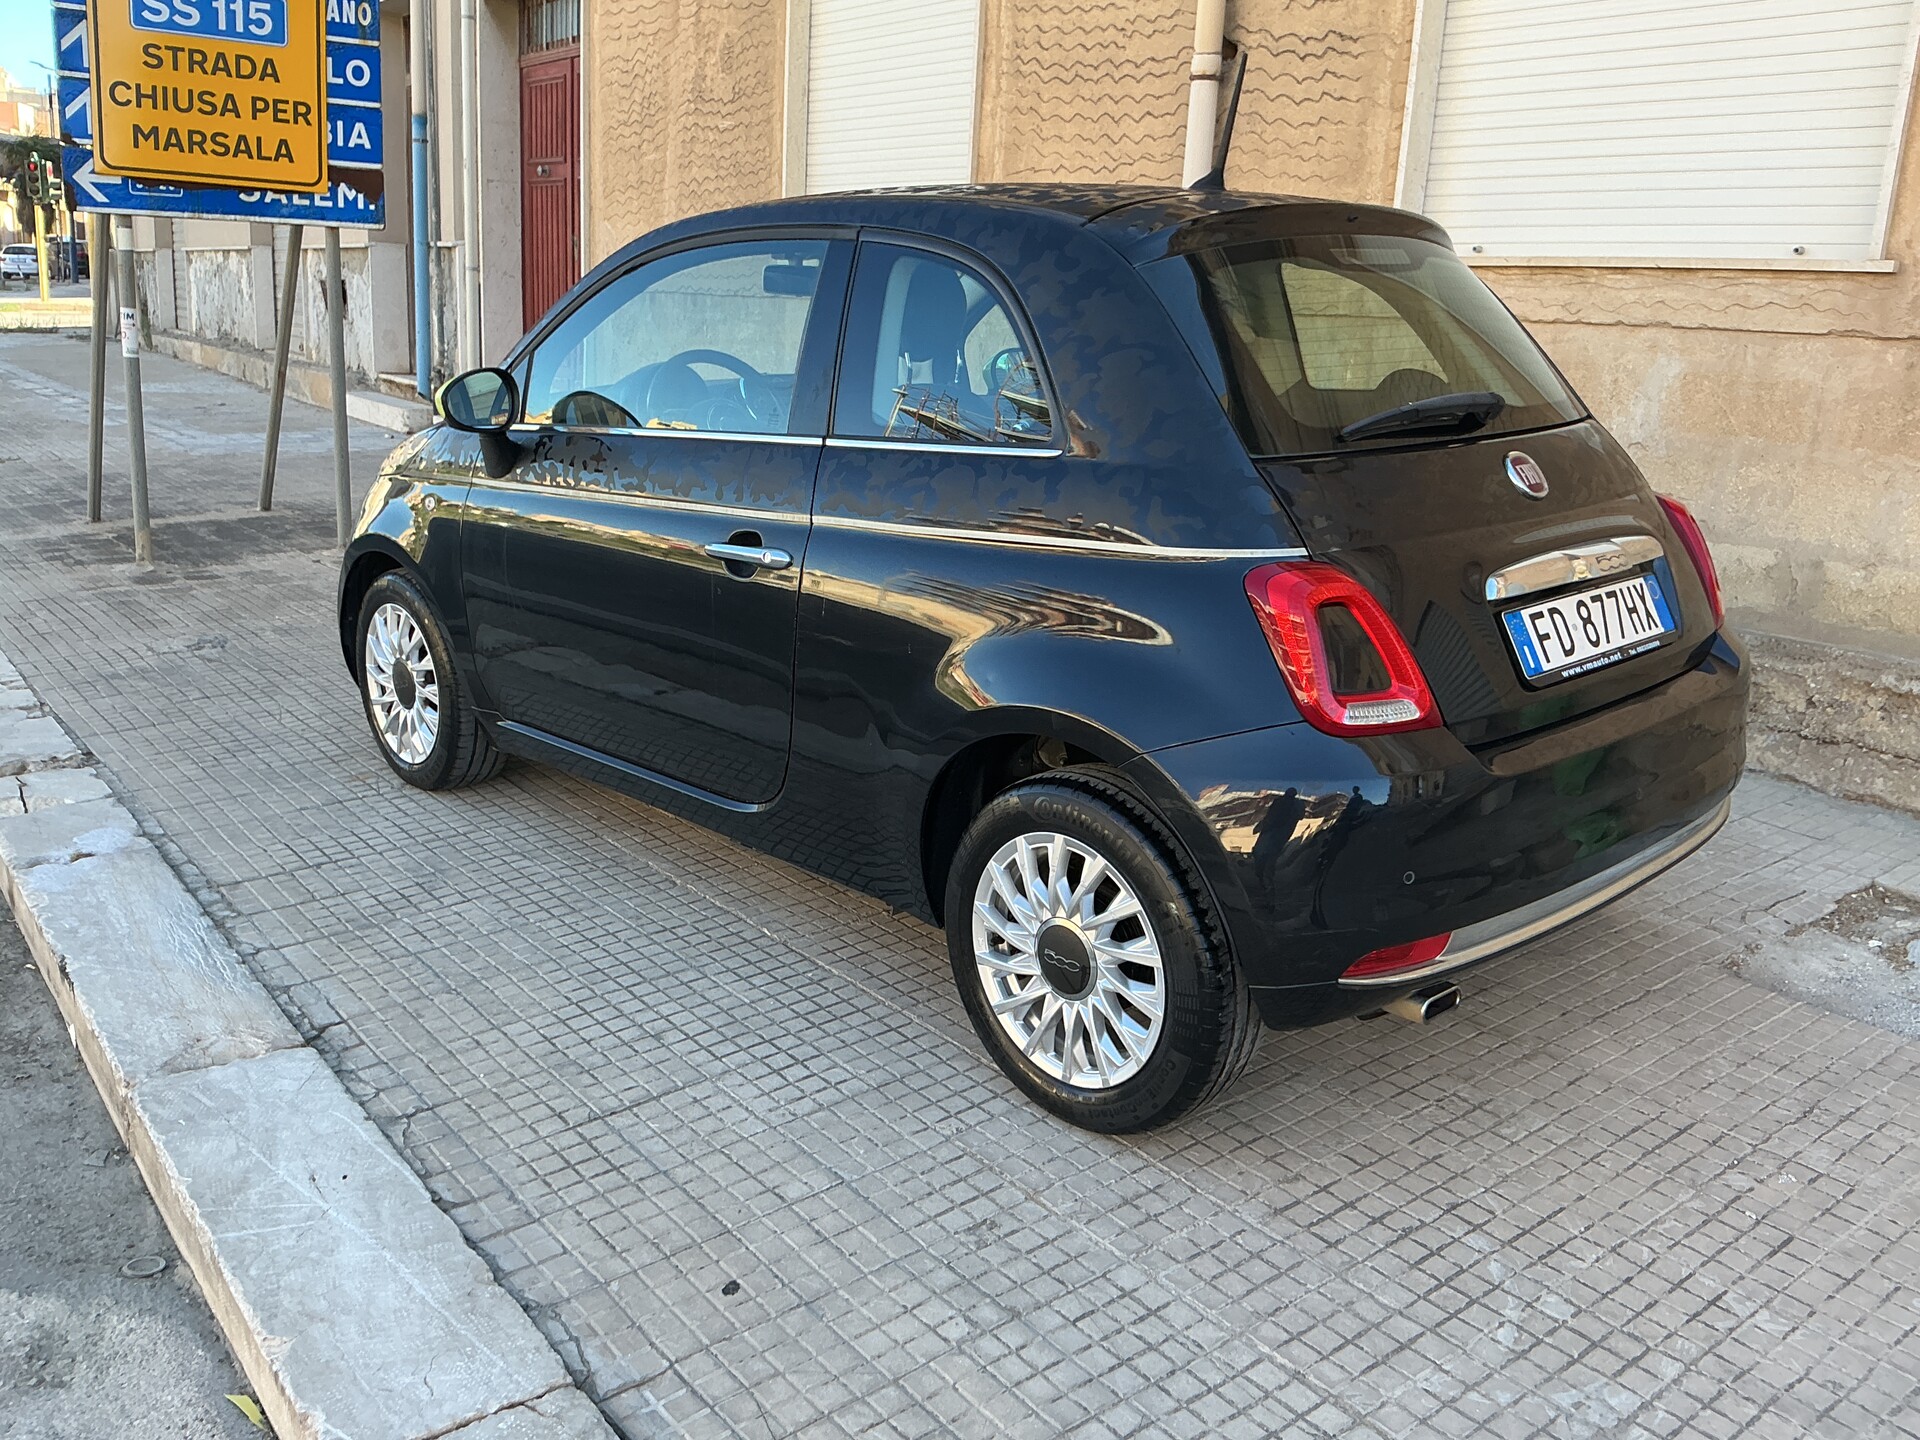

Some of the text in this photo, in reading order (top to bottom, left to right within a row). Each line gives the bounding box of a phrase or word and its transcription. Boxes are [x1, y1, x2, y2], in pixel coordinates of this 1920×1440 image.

[140, 0, 273, 36] SS 115
[141, 43, 281, 83] STRADA
[108, 80, 312, 126] CHIUSA PER
[132, 123, 295, 164] MARSALA
[1514, 463, 1541, 486] FIAT
[1595, 553, 1628, 573] 500
[1528, 582, 1660, 665] FD 877HX
[1043, 947, 1081, 973] 500
